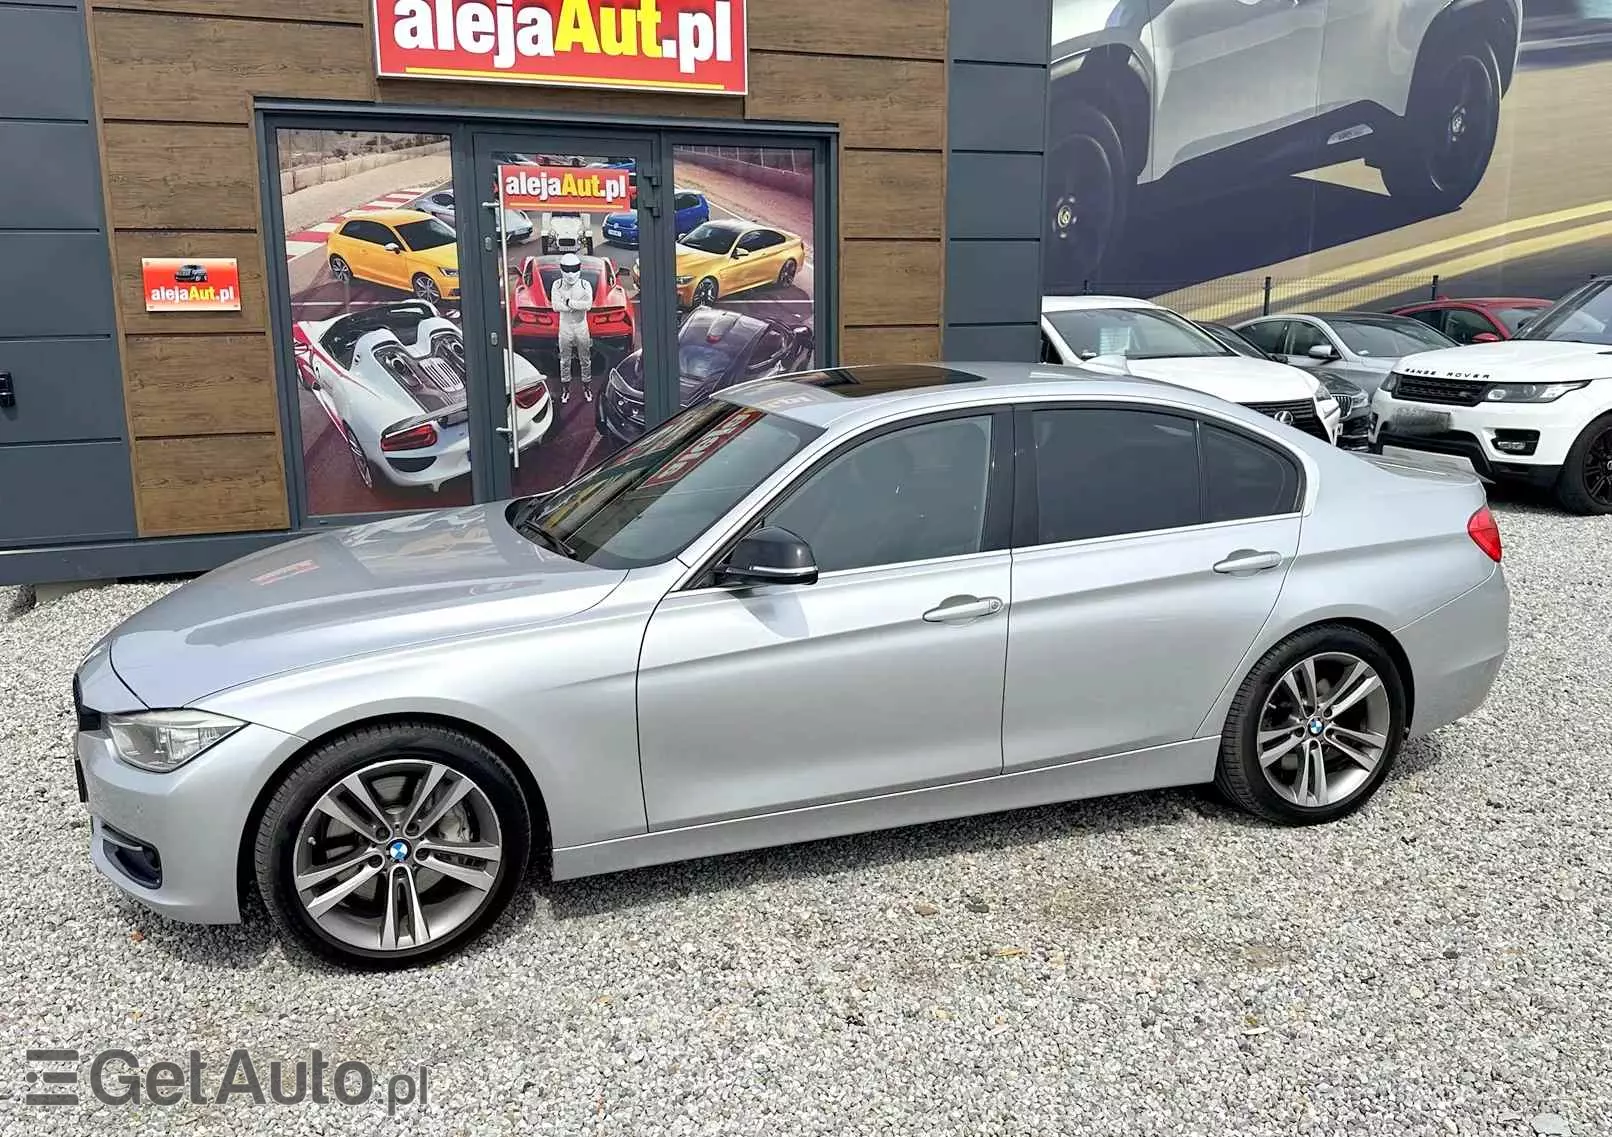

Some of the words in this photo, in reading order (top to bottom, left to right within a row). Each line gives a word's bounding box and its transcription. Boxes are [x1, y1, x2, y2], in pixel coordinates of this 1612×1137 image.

[393, 0, 733, 74] alejaAut.pl
[505, 171, 626, 203] alejaAut.pl
[151, 286, 235, 303] alejaAut.pl
